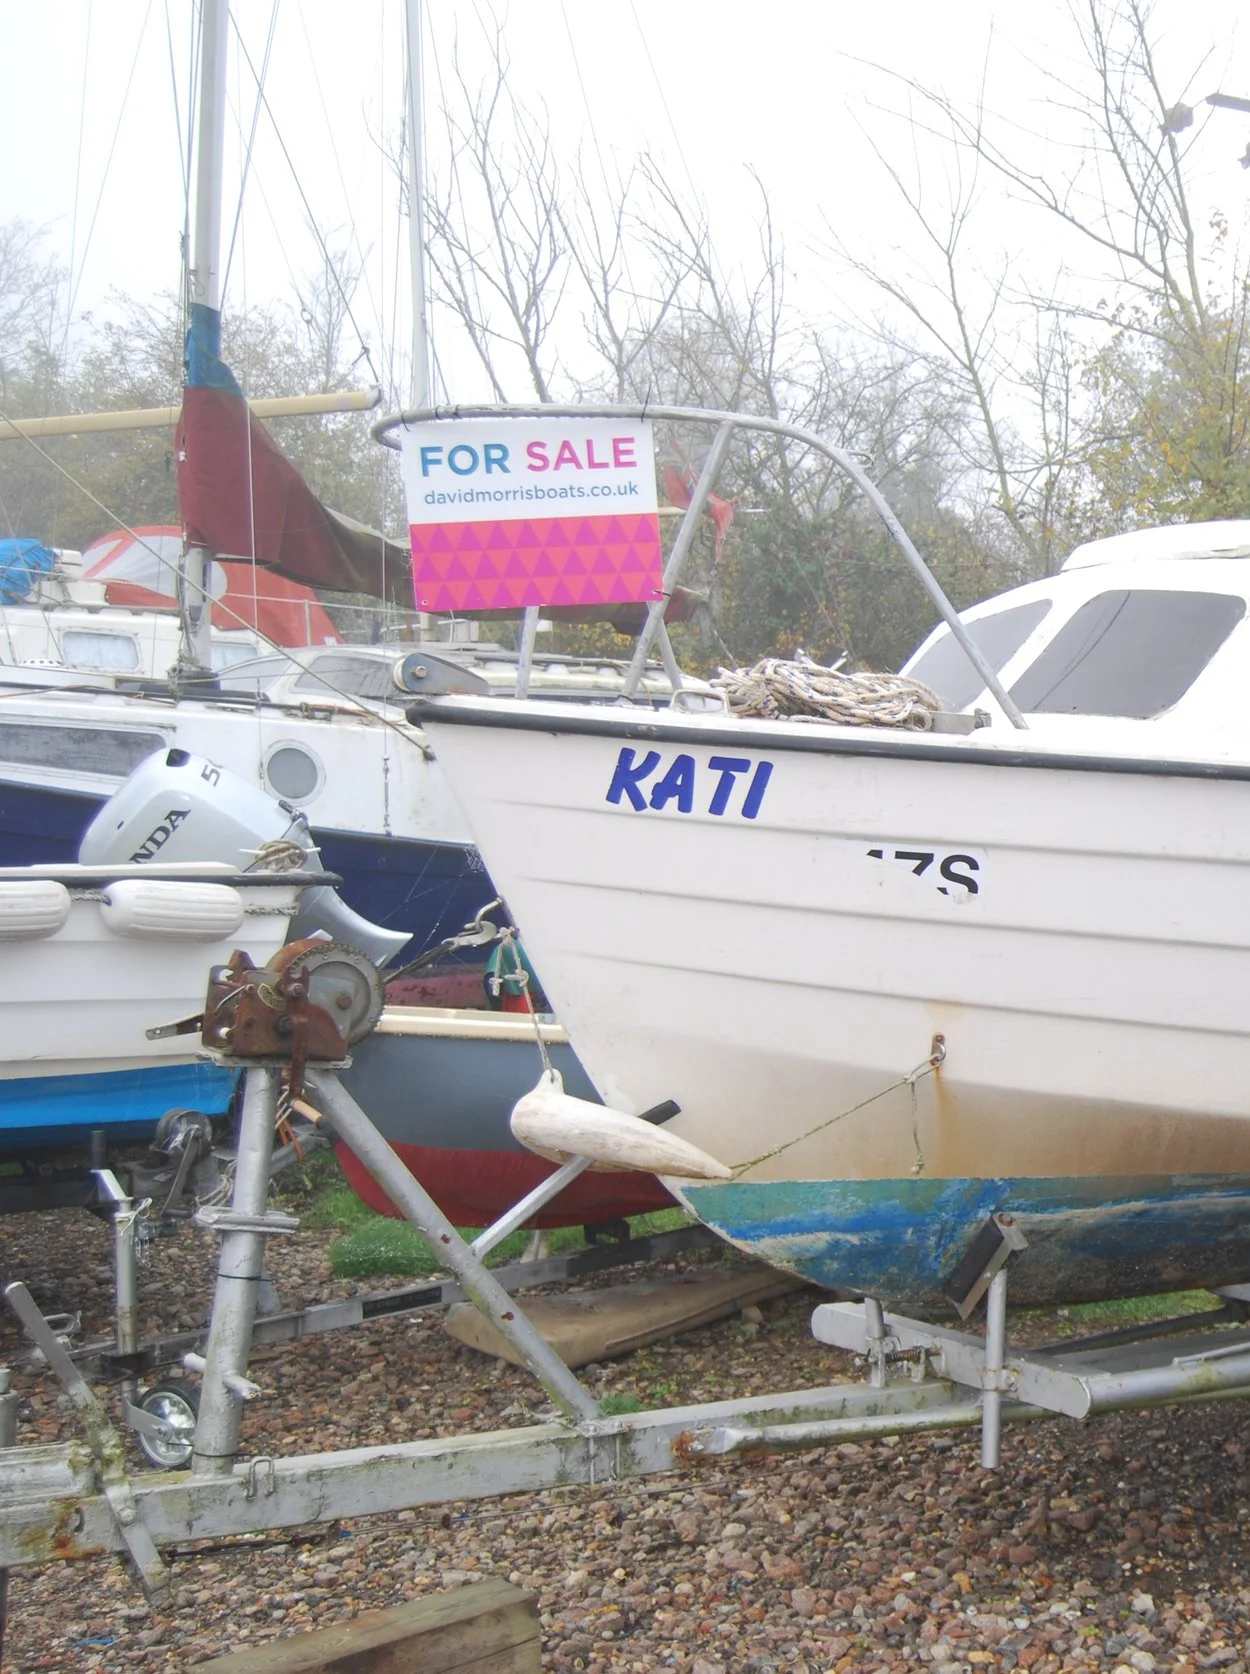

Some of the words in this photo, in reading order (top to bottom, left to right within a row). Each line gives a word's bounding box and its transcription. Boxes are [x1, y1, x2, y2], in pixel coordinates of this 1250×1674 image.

[419, 443, 511, 477] FOR
[525, 436, 638, 472] SALE
[424, 480, 639, 506] davidmorrisboats.co.uk
[605, 747, 774, 820] KATI
[865, 849, 980, 896] 7S
